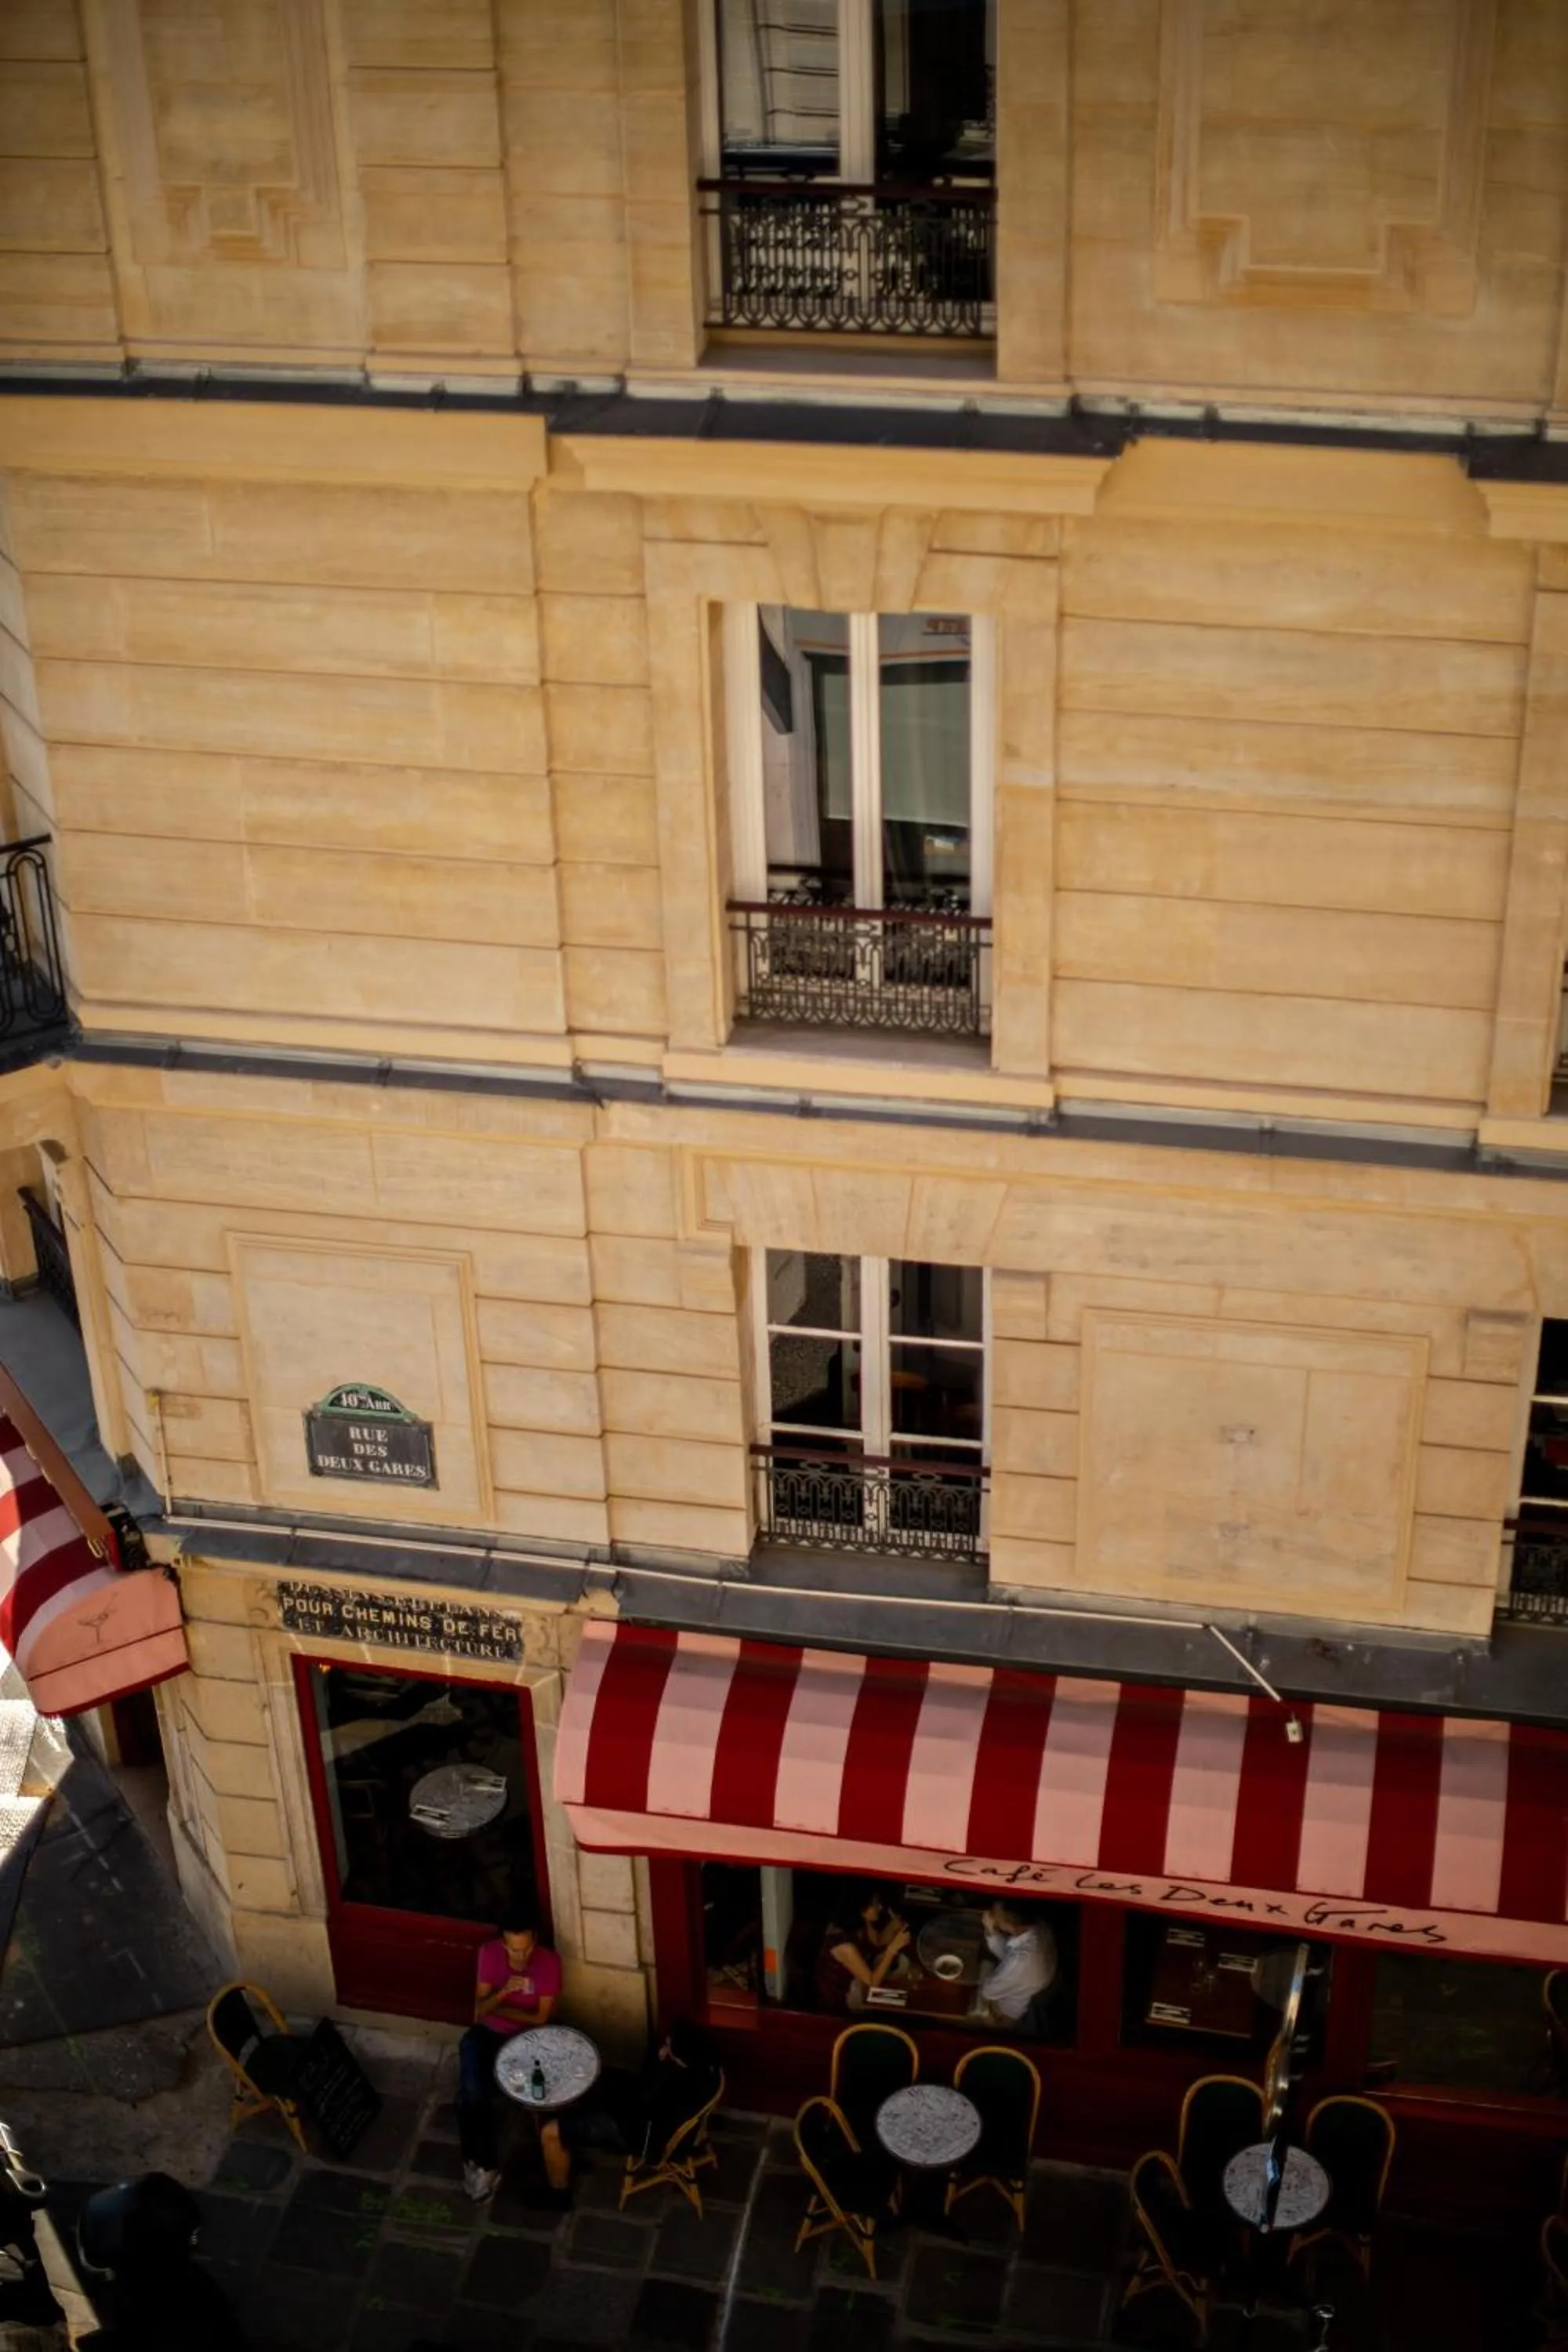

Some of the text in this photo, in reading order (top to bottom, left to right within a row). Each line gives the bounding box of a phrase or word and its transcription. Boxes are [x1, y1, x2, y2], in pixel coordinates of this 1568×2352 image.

[349, 1425, 389, 1443] RUE
[353, 1443, 388, 1457] DES
[317, 1454, 426, 1478] DEUX GARES
[282, 1595, 517, 1641] POUR CHEMINS DE FER
[943, 1858, 1057, 1883] Café
[1160, 1884, 1289, 1915] Deux
[1304, 1901, 1447, 1944] Gares
